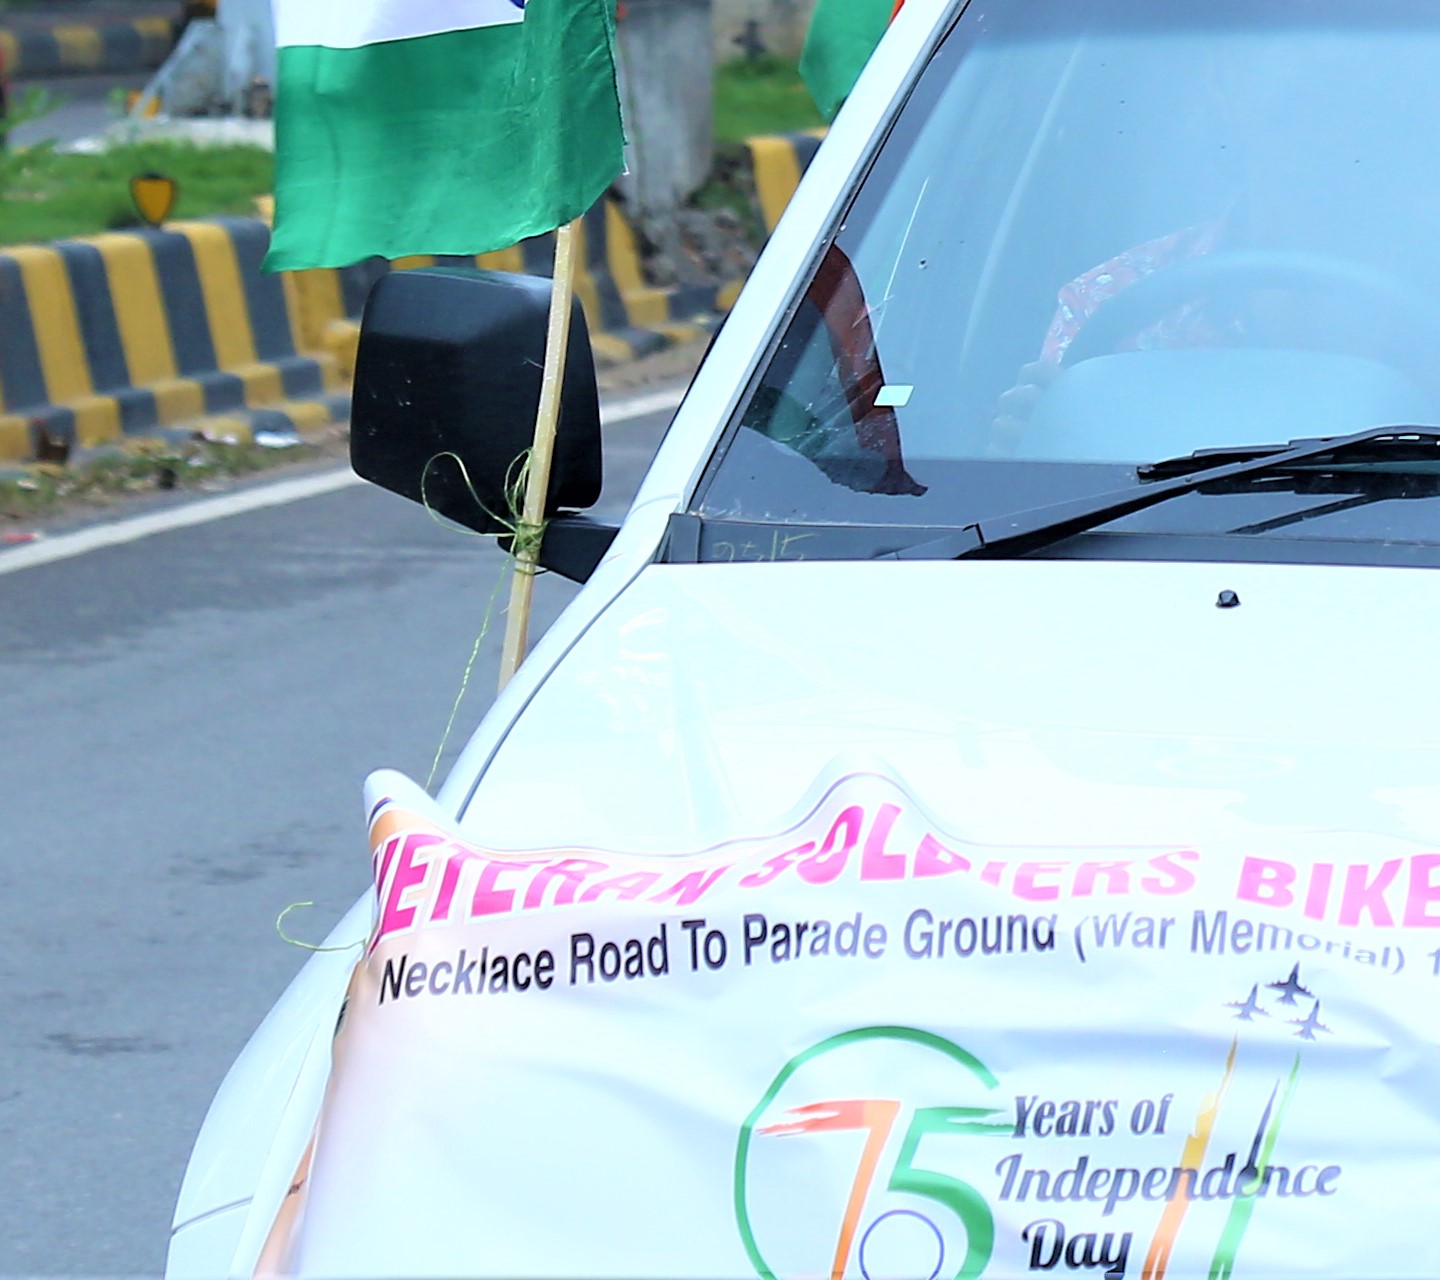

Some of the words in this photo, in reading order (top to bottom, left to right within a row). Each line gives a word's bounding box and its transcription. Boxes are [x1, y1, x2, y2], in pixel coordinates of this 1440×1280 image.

[378, 945, 554, 1005] Necklace
[569, 923, 669, 986] Road
[681, 920, 727, 970] To
[743, 912, 886, 966] Parade
[902, 909, 1056, 960] Ground
[1074, 912, 1175, 964] (War
[1190, 909, 1405, 975] Memorial)
[1012, 1094, 1118, 1139] Years
[1130, 1093, 1174, 1136] of
[994, 1152, 1342, 1217] Independence
[1021, 1219, 1133, 1280] Day
